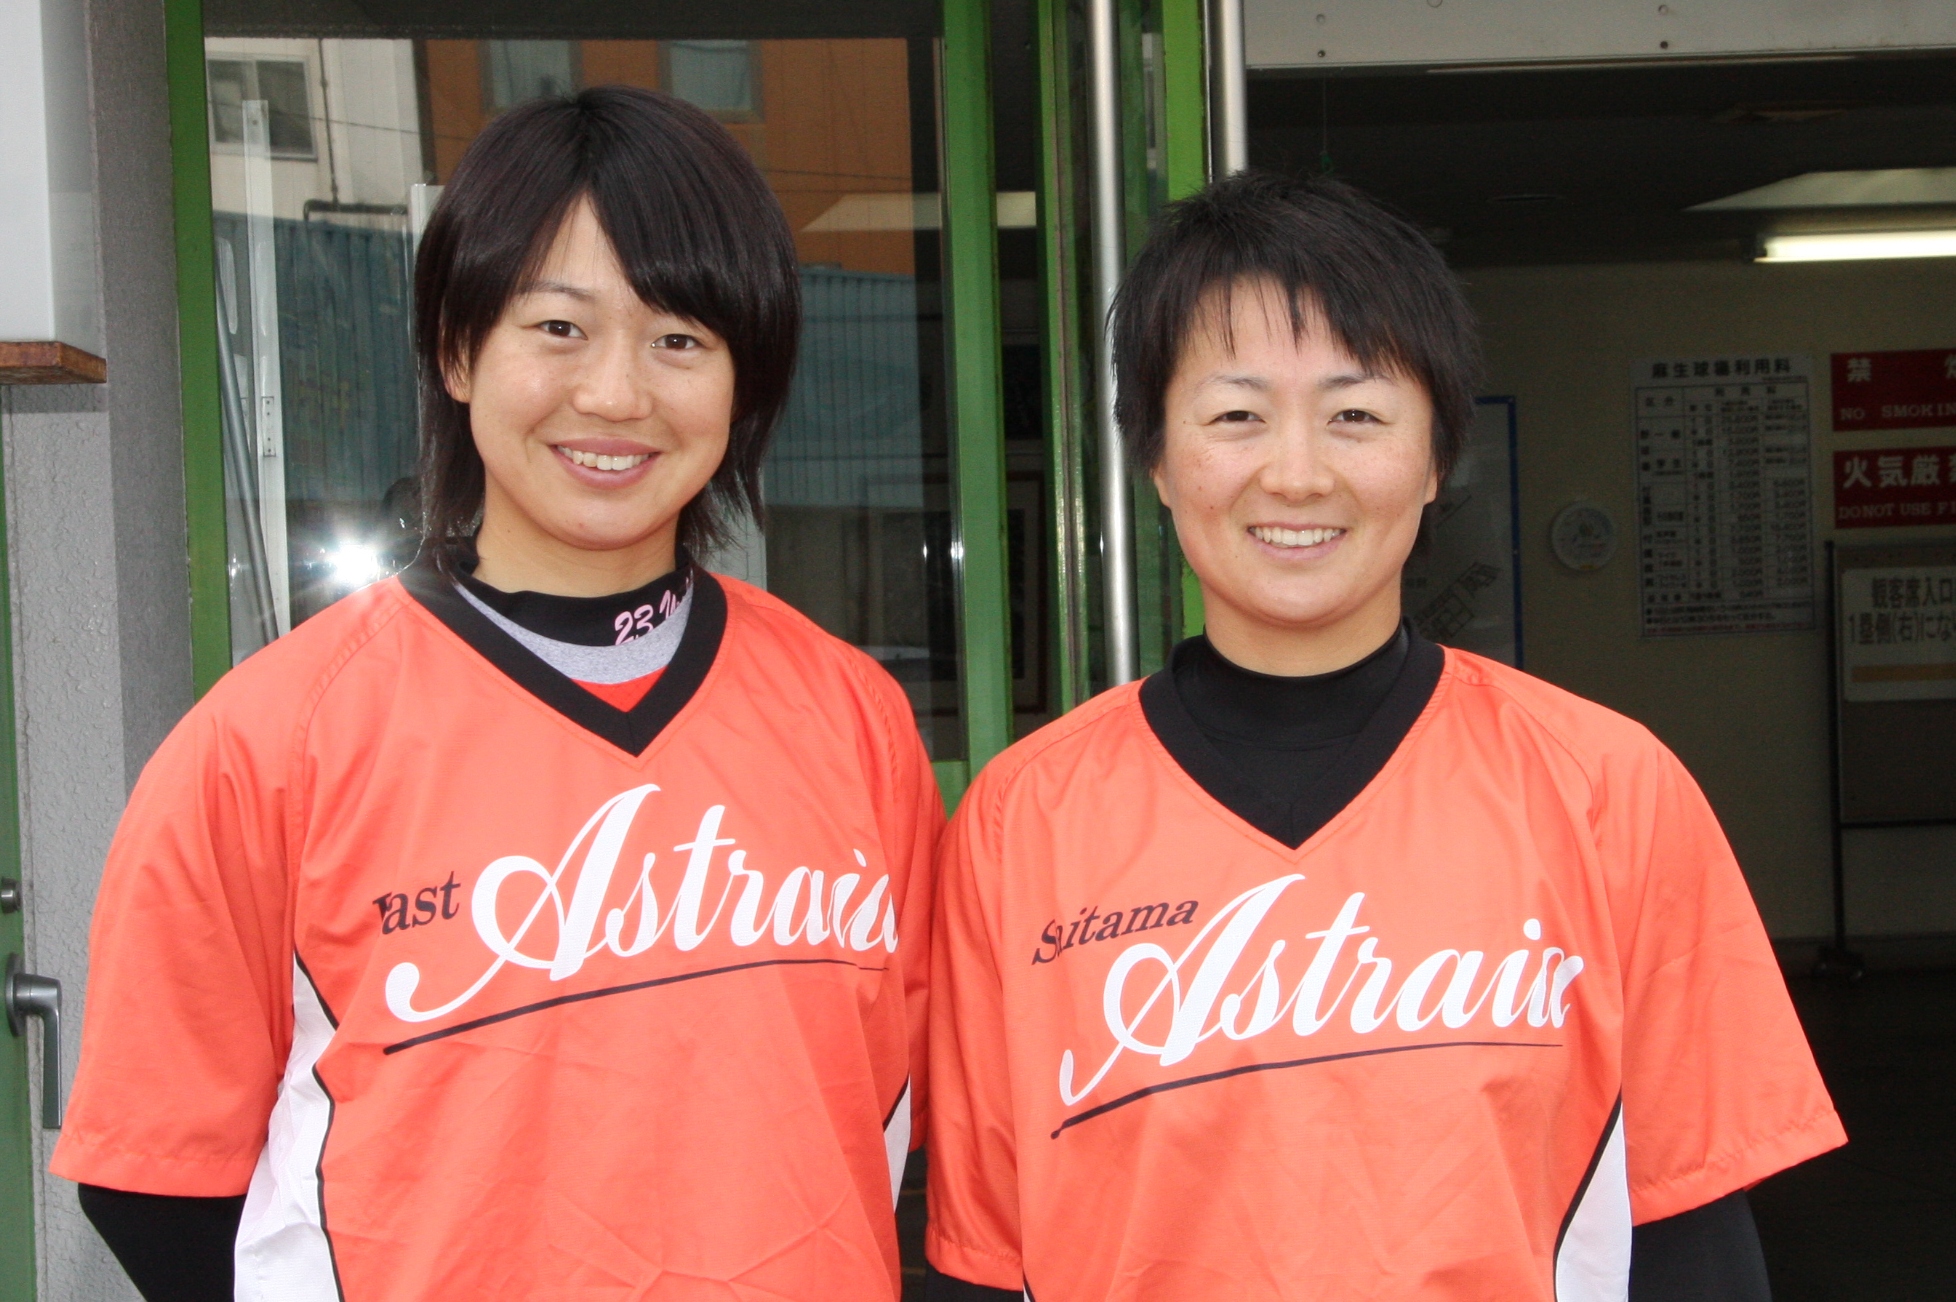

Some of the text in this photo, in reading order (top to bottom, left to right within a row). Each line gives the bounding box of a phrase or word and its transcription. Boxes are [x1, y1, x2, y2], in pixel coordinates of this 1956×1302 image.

[1840, 408, 1866, 422] NO
[1843, 454, 1956, 491] 火気厳
[1900, 503, 1934, 520] USE
[1872, 575, 1956, 609] 観客席入口
[614, 604, 654, 646] 23
[1031, 900, 1199, 966] Sitama
